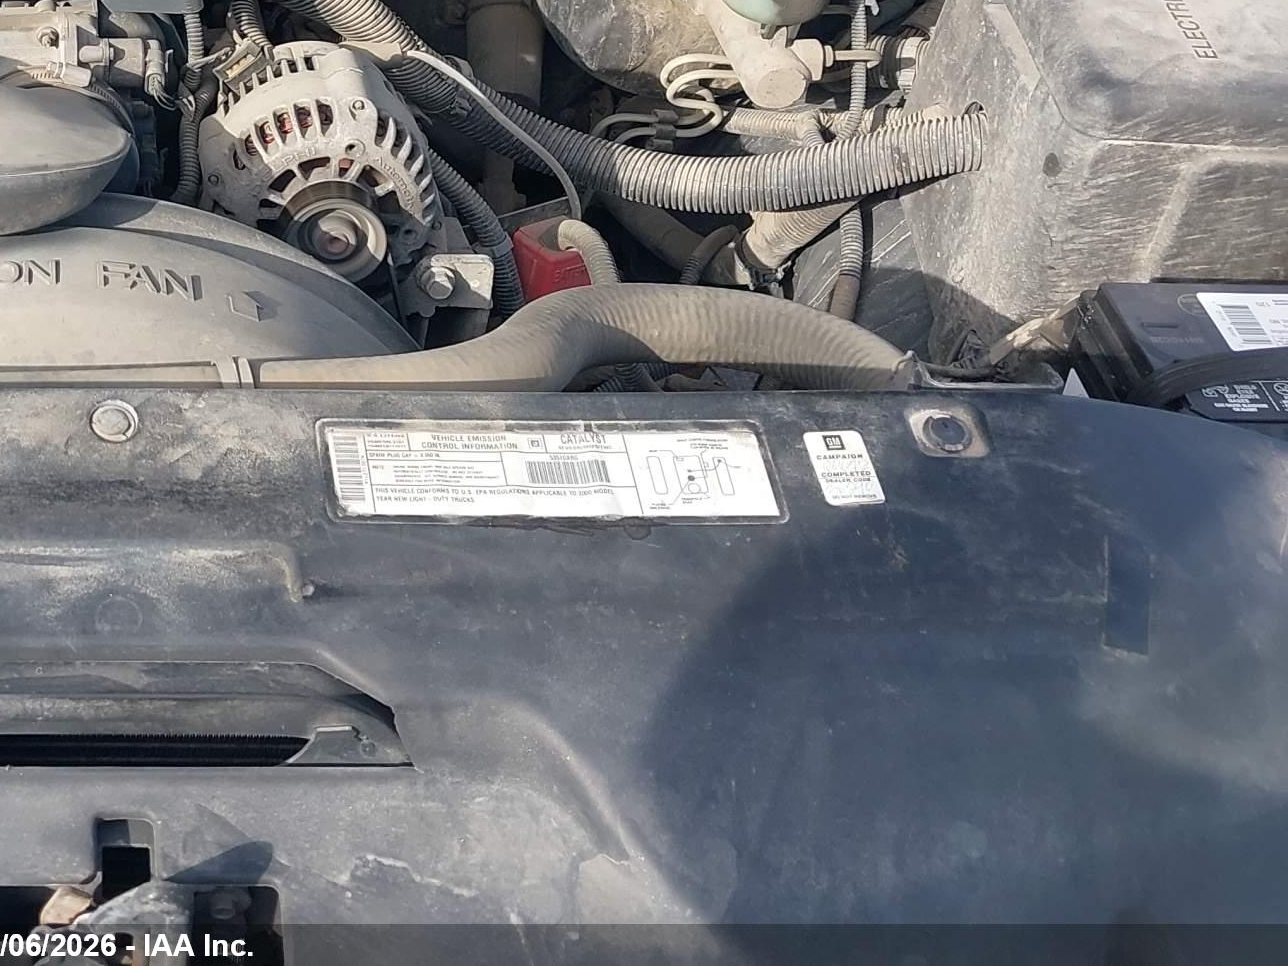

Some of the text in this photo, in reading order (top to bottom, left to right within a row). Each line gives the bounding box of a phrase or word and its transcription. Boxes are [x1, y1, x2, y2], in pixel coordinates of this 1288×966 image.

[96, 259, 203, 301] FAN
[560, 433, 608, 445] CATALYST
[421, 442, 458, 450] CONTROL
[821, 470, 871, 478] COMPLETED
